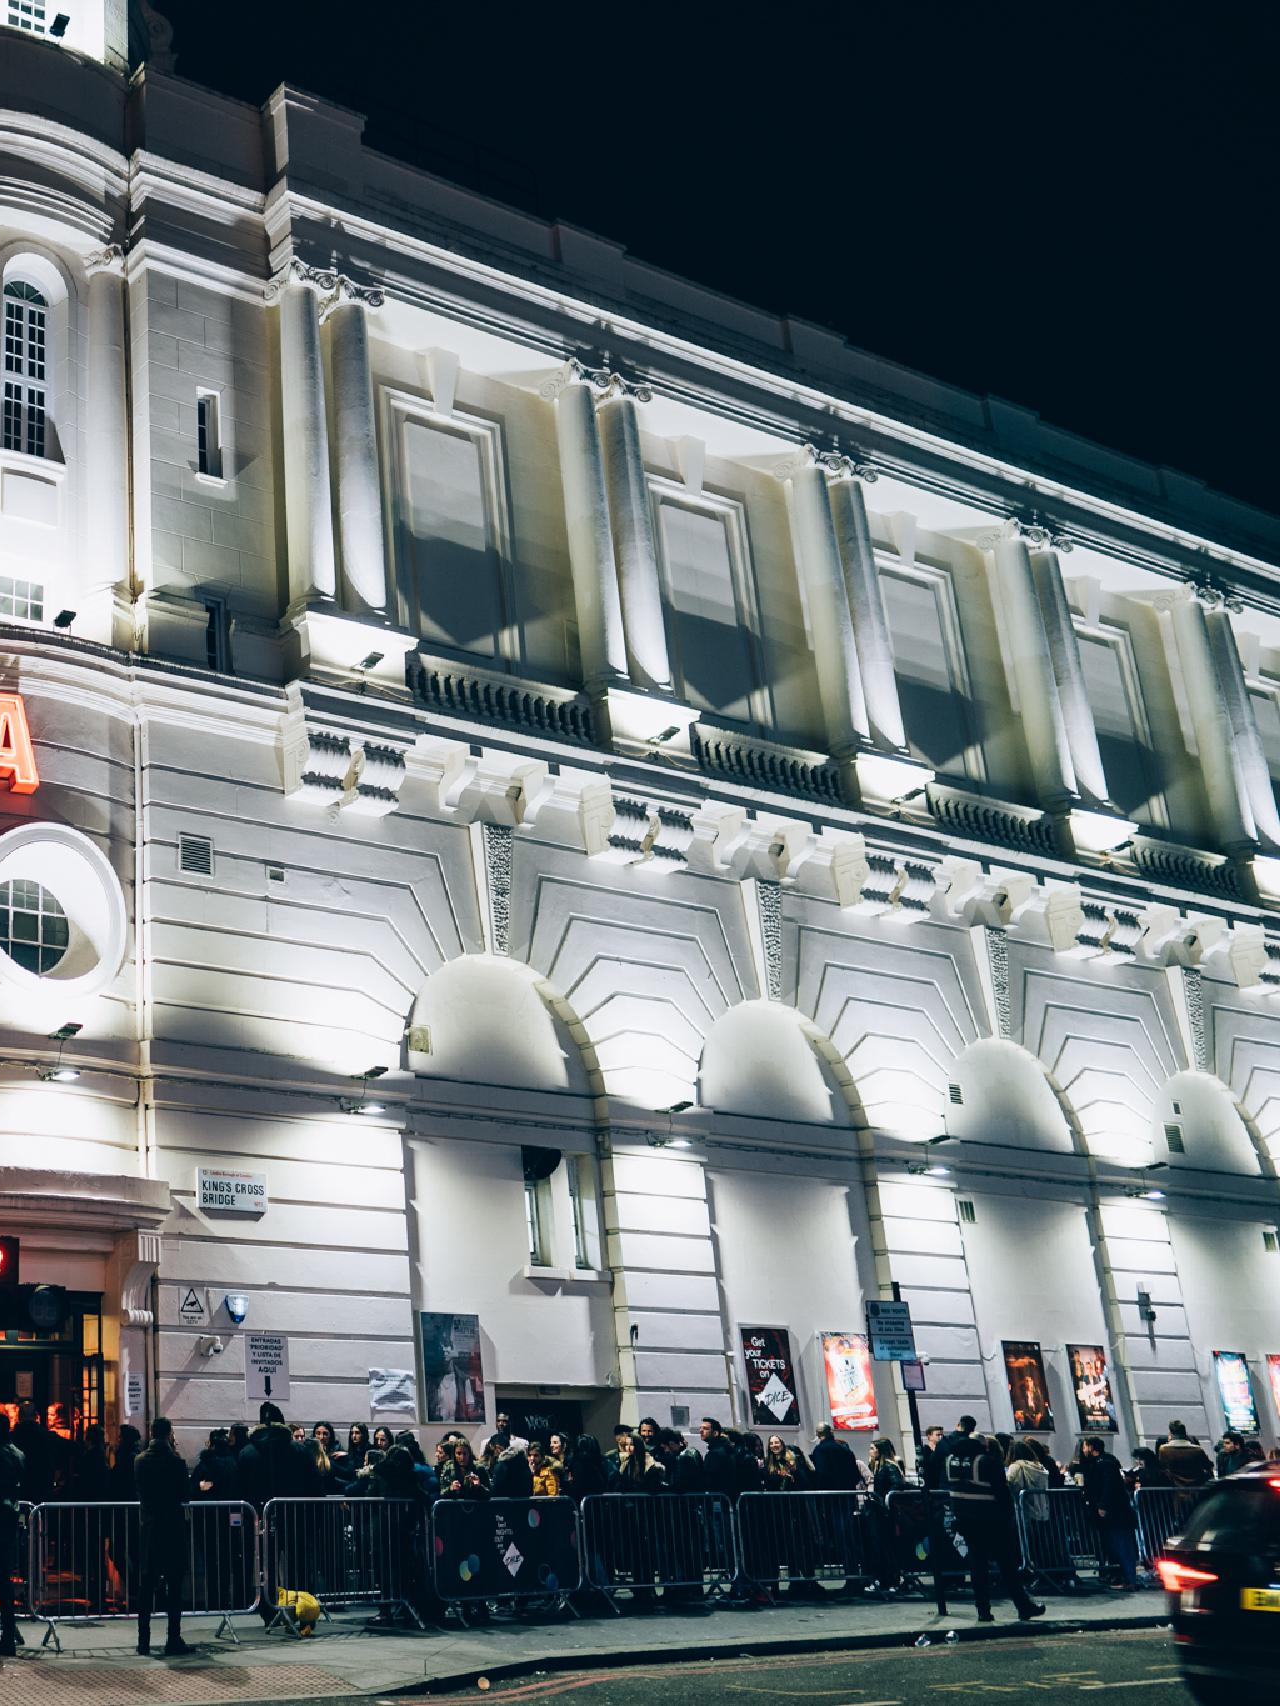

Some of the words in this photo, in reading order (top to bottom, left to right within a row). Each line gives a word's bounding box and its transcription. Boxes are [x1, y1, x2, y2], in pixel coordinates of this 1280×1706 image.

[203, 1180, 232, 1193] KING'S
[235, 1183, 265, 1196] CROSS
[203, 1193, 236, 1206] BRIDGE
[751, 1336, 765, 1347] Get
[745, 1349, 761, 1360] your
[753, 1359, 786, 1370] TICKETS
[759, 1370, 770, 1378] on
